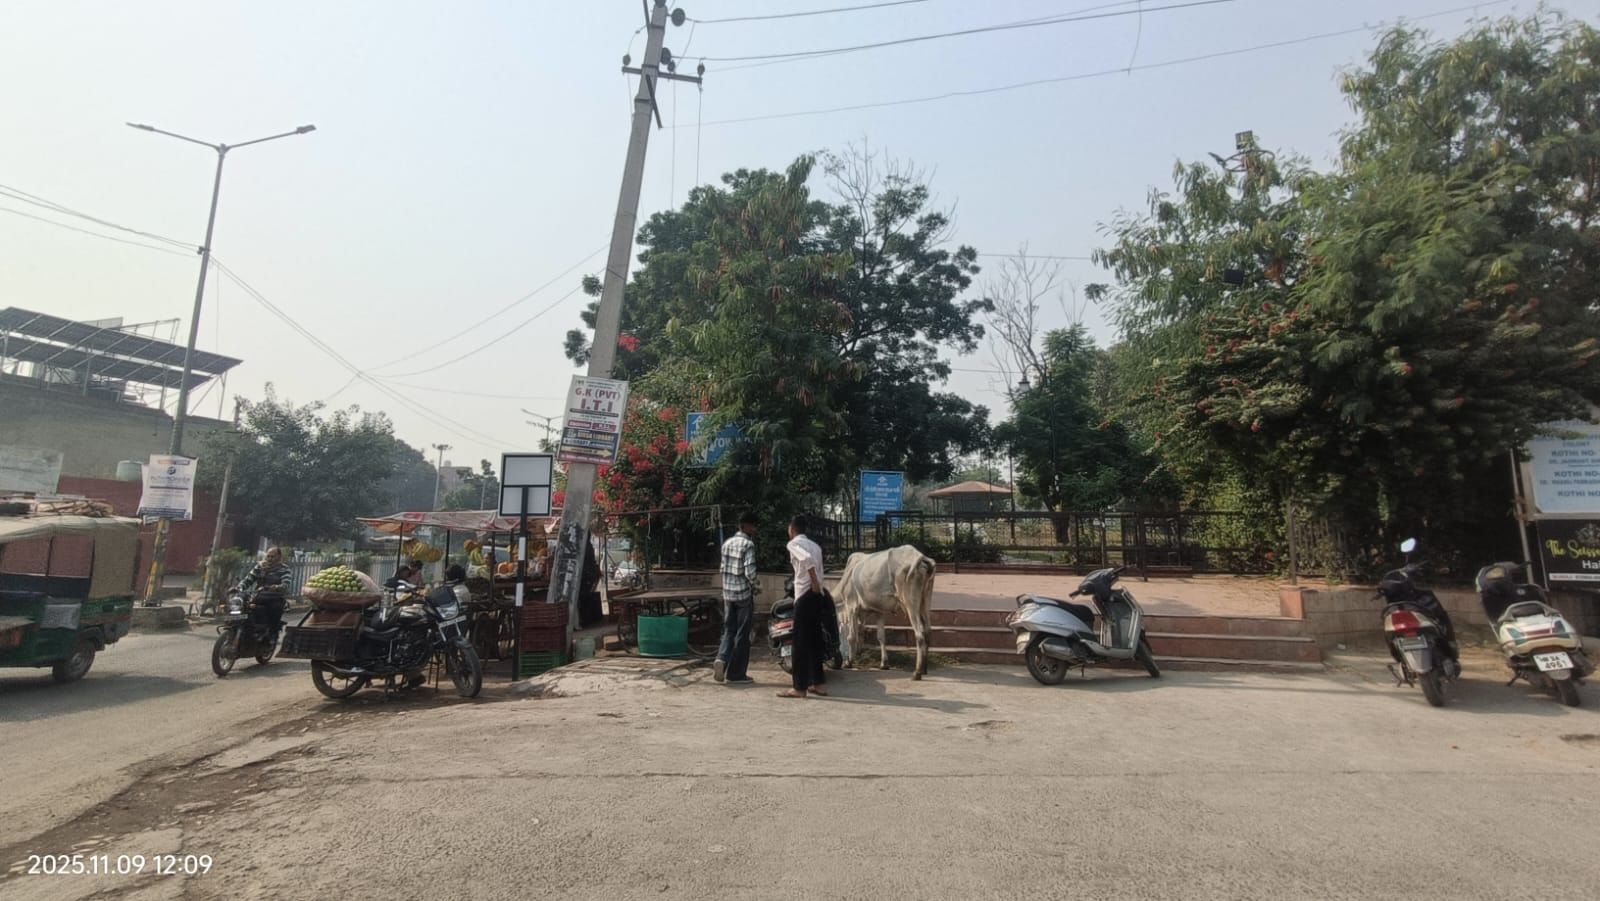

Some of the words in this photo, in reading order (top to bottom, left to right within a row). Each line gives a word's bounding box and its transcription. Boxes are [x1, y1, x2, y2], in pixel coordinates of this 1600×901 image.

[575, 388, 592, 397] G.K
[595, 389, 621, 400] (PVT)
[581, 398, 613, 412] I.T.I
[1545, 539, 1567, 558] The
